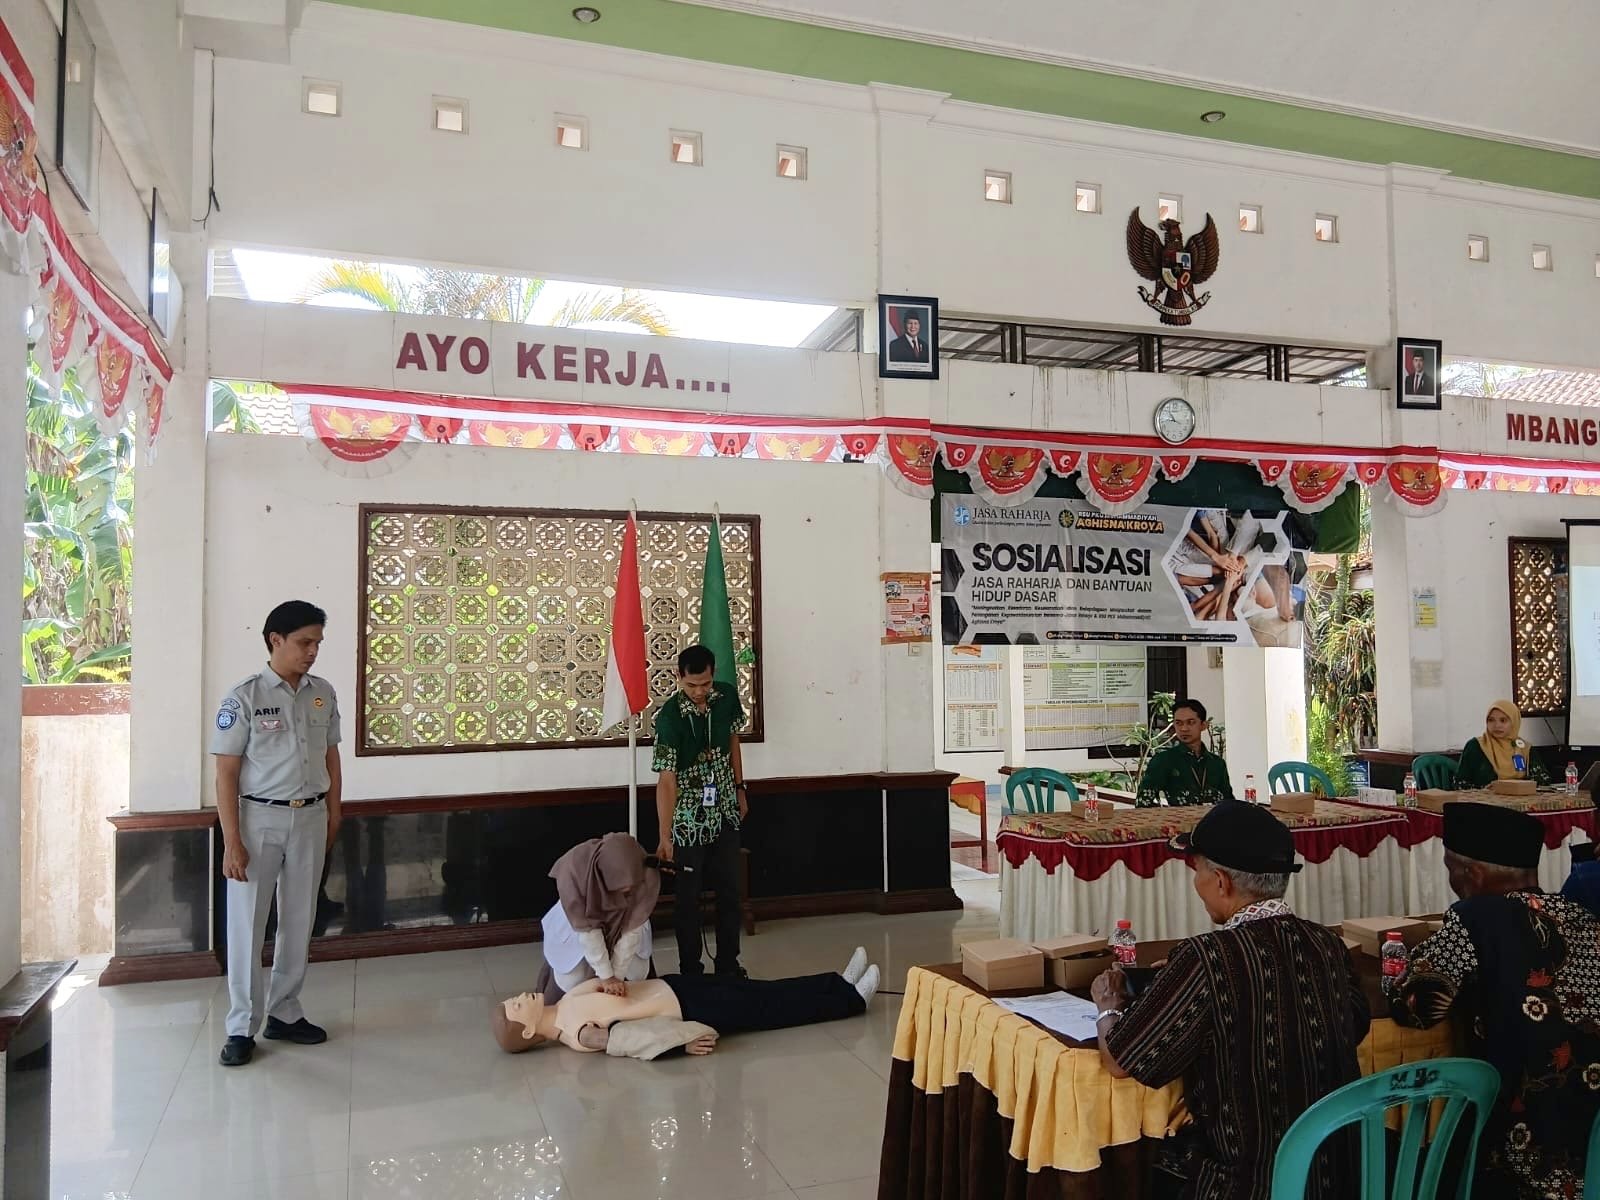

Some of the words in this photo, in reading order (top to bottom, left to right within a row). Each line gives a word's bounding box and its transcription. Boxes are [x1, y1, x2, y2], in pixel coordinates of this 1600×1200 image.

[396, 332, 490, 374] AYO
[517, 341, 731, 393] KERJA....
[1506, 413, 1600, 446] MBANG
[973, 507, 997, 519] JASA
[1000, 508, 1051, 521] RAHARJA
[1077, 518, 1124, 530] AGHISNA
[1126, 521, 1164, 531] KROYA
[972, 543, 1151, 576] SOSIALISASI
[971, 576, 1004, 589] JASA
[1007, 577, 1062, 590] RAHARJA
[1067, 579, 1090, 590] DAN
[1093, 580, 1152, 592] BANTUAN
[972, 591, 1011, 602] HIDUP
[1014, 591, 1056, 602] DASAR
[254, 707, 280, 716] ARIF
